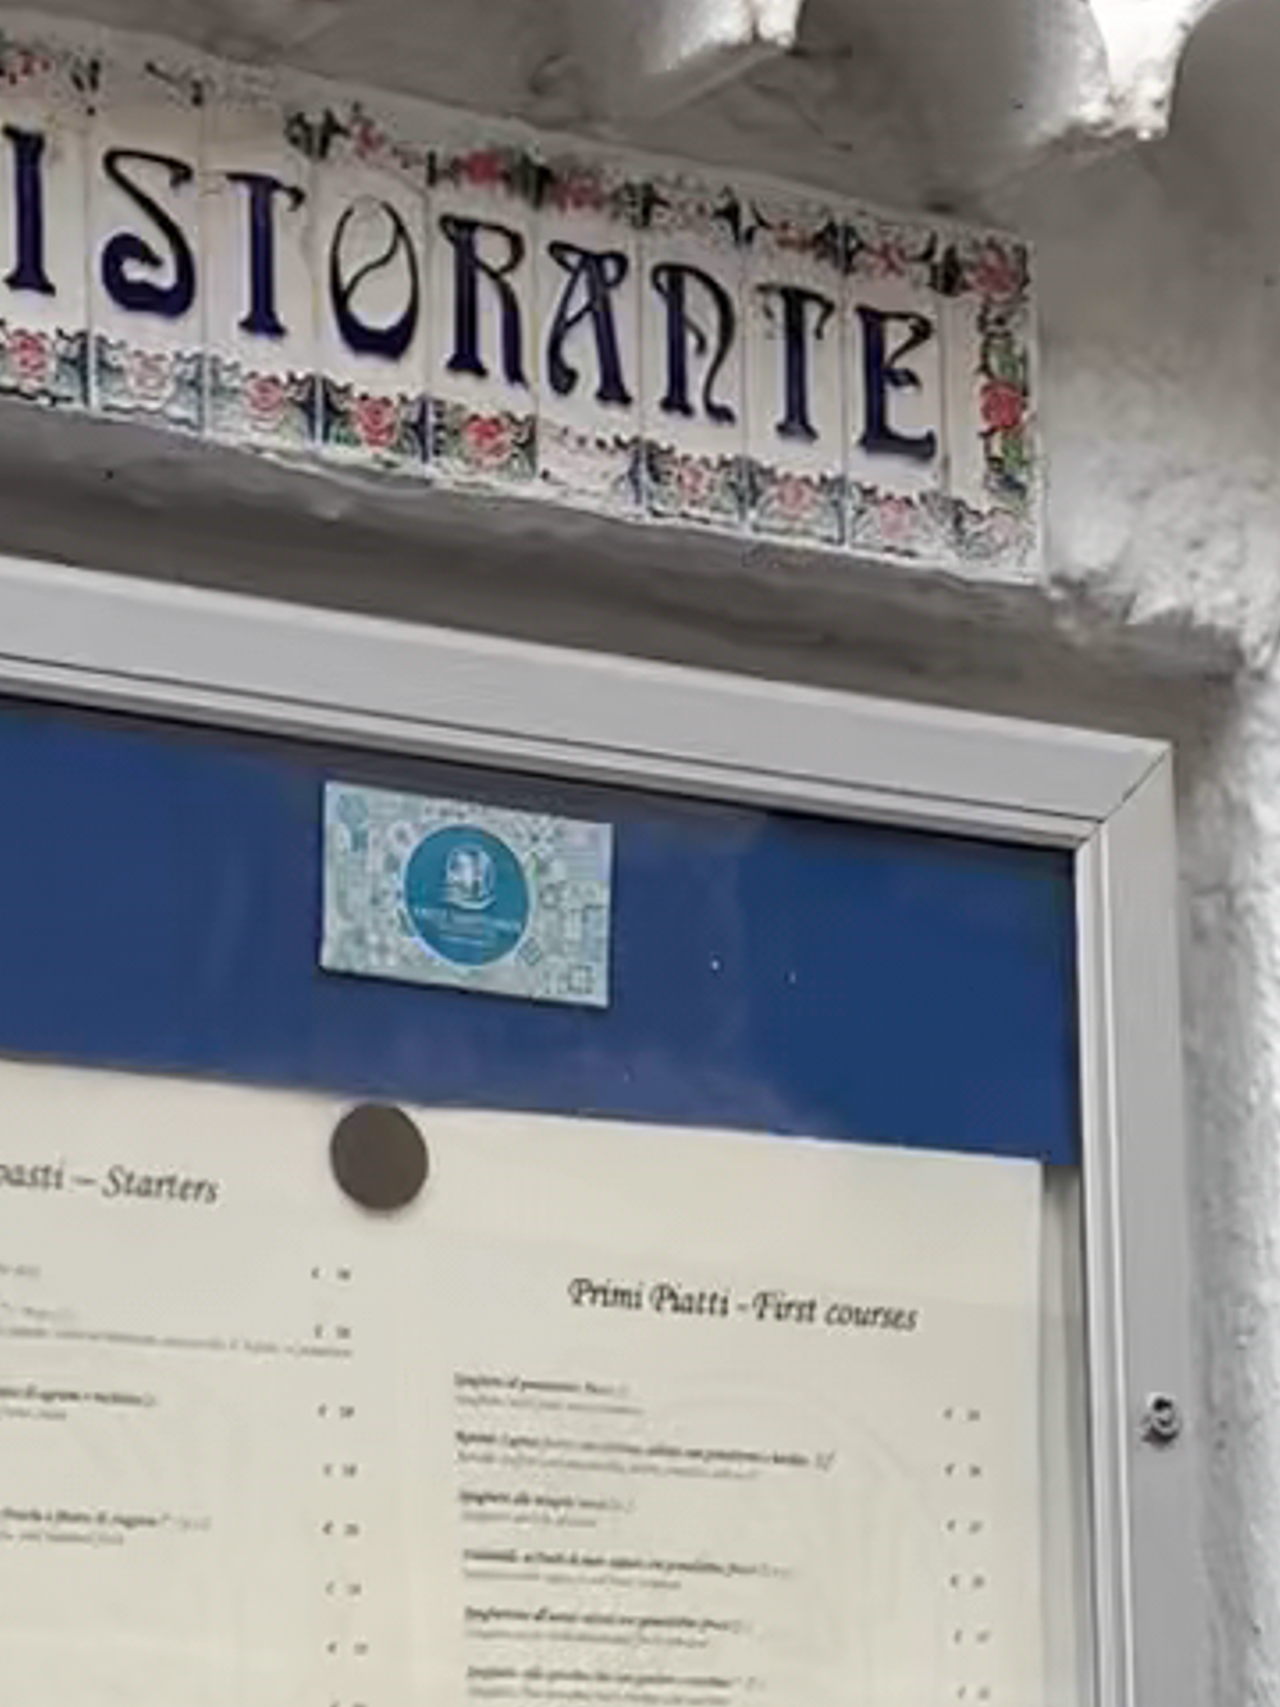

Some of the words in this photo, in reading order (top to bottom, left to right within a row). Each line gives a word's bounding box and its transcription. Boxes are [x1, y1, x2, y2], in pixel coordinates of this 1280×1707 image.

[102, 1165, 219, 1204] Starters
[568, 1278, 643, 1311] Primi
[649, 1283, 730, 1319] Piatti
[824, 1302, 918, 1331] courses
